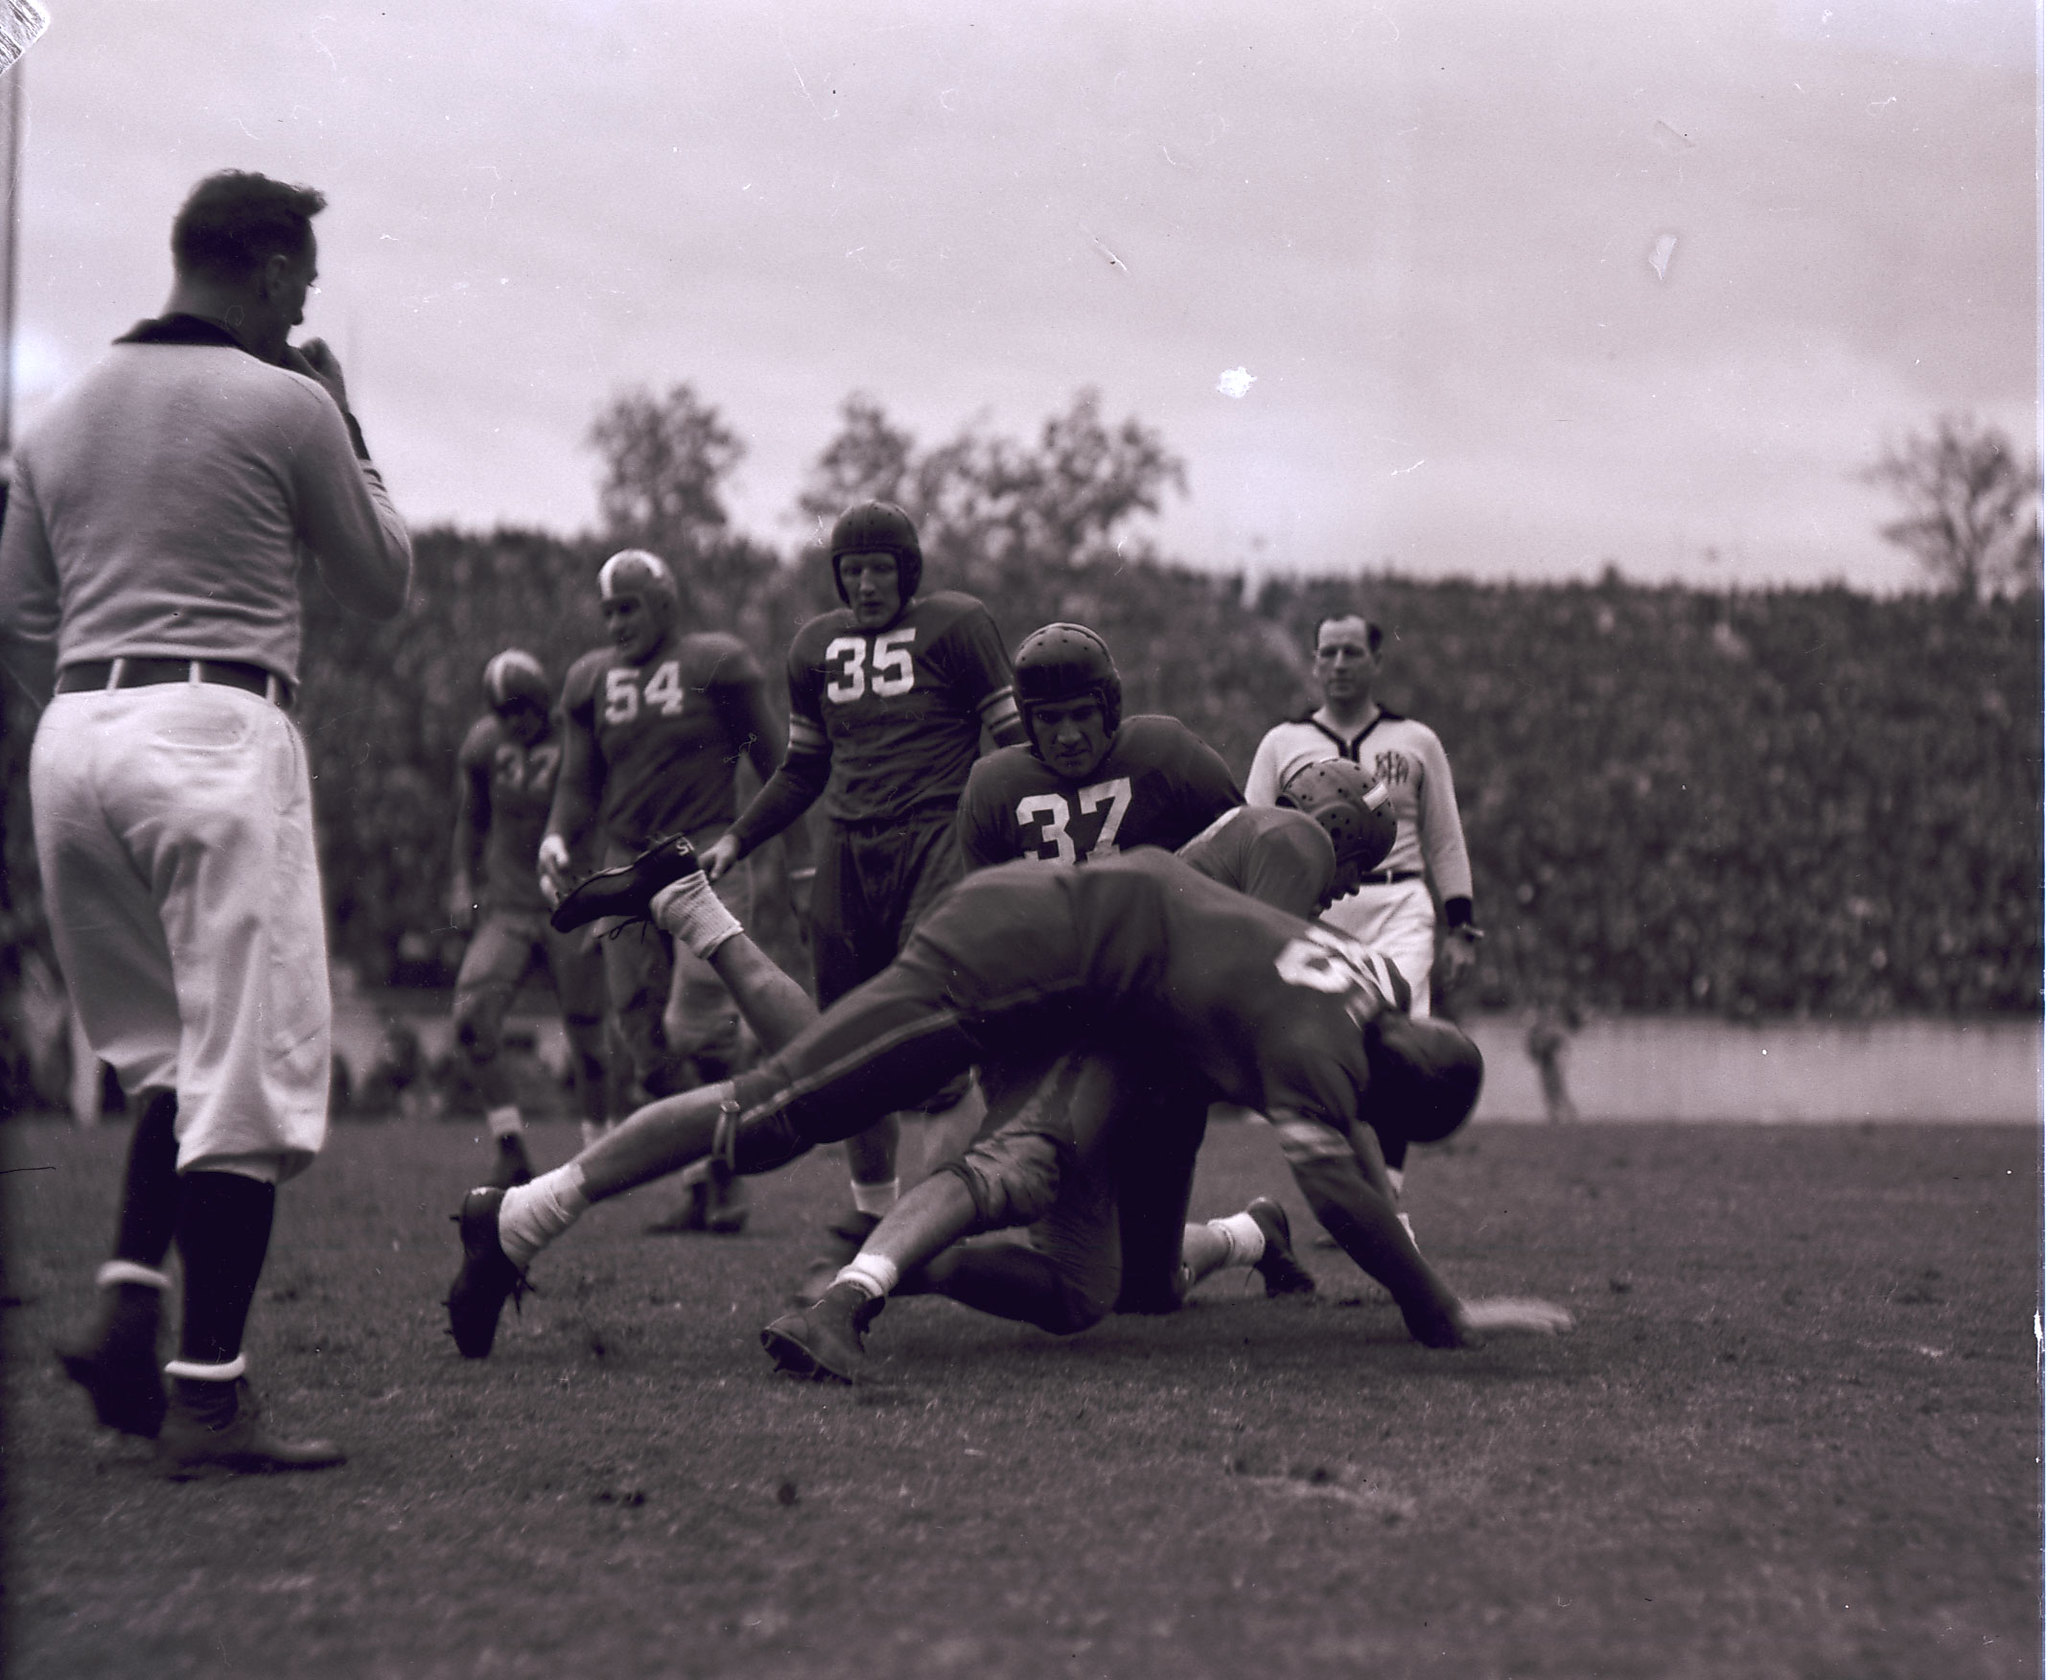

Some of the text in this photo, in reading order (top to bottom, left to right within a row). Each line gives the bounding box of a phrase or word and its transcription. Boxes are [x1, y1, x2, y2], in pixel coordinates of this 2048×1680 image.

[605, 661, 683, 724] 54
[825, 627, 916, 704] 35
[1016, 777, 1132, 865] 37
